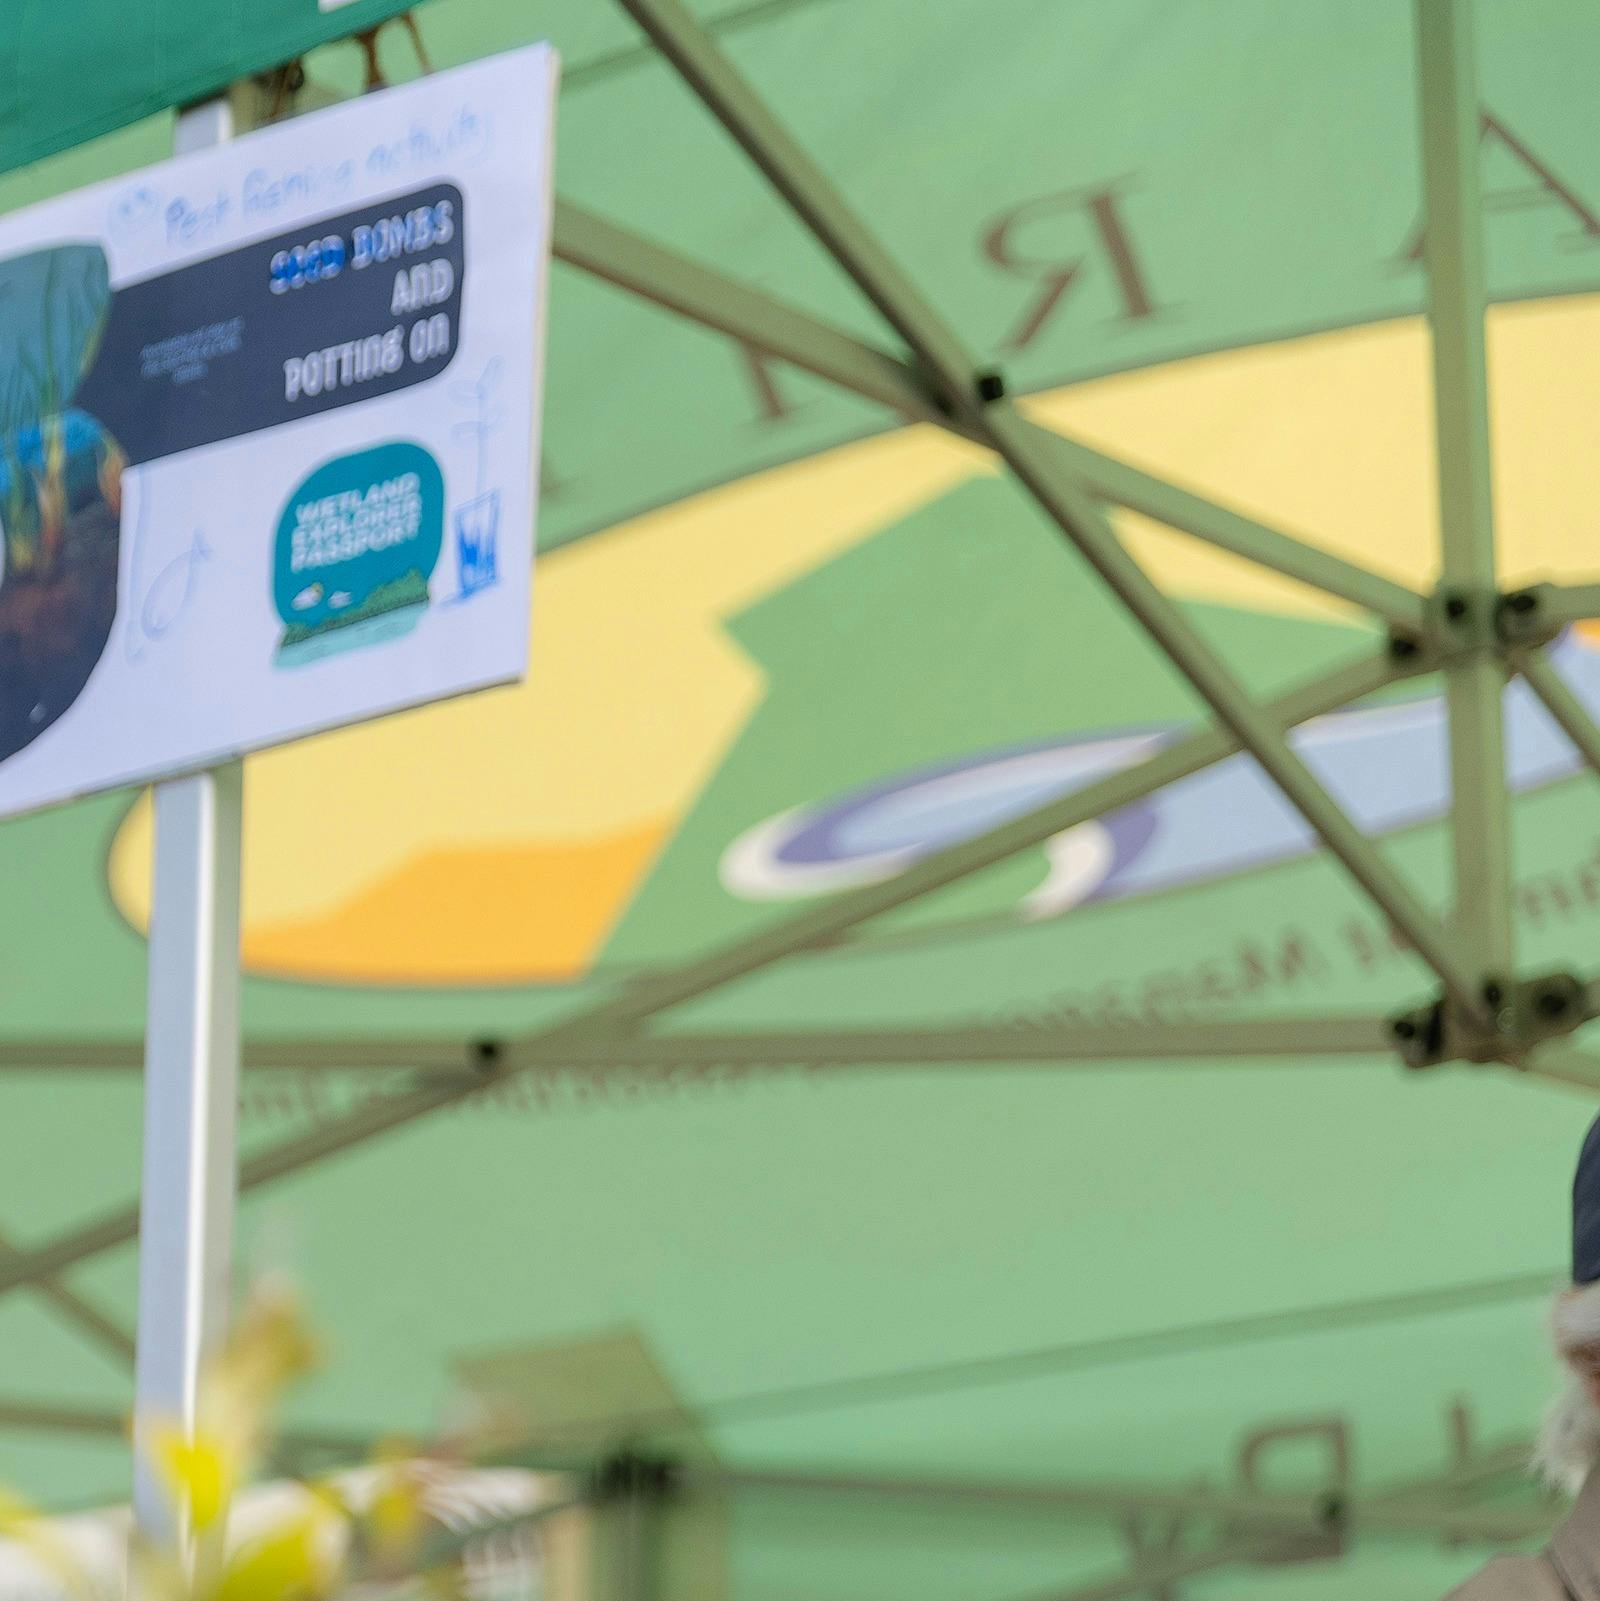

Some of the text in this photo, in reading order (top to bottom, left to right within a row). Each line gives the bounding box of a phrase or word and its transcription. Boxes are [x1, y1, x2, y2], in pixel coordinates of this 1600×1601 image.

[292, 492, 422, 550] EXPLORER
[296, 472, 420, 524] WETLAND
[291, 512, 419, 574] PASSPORT
